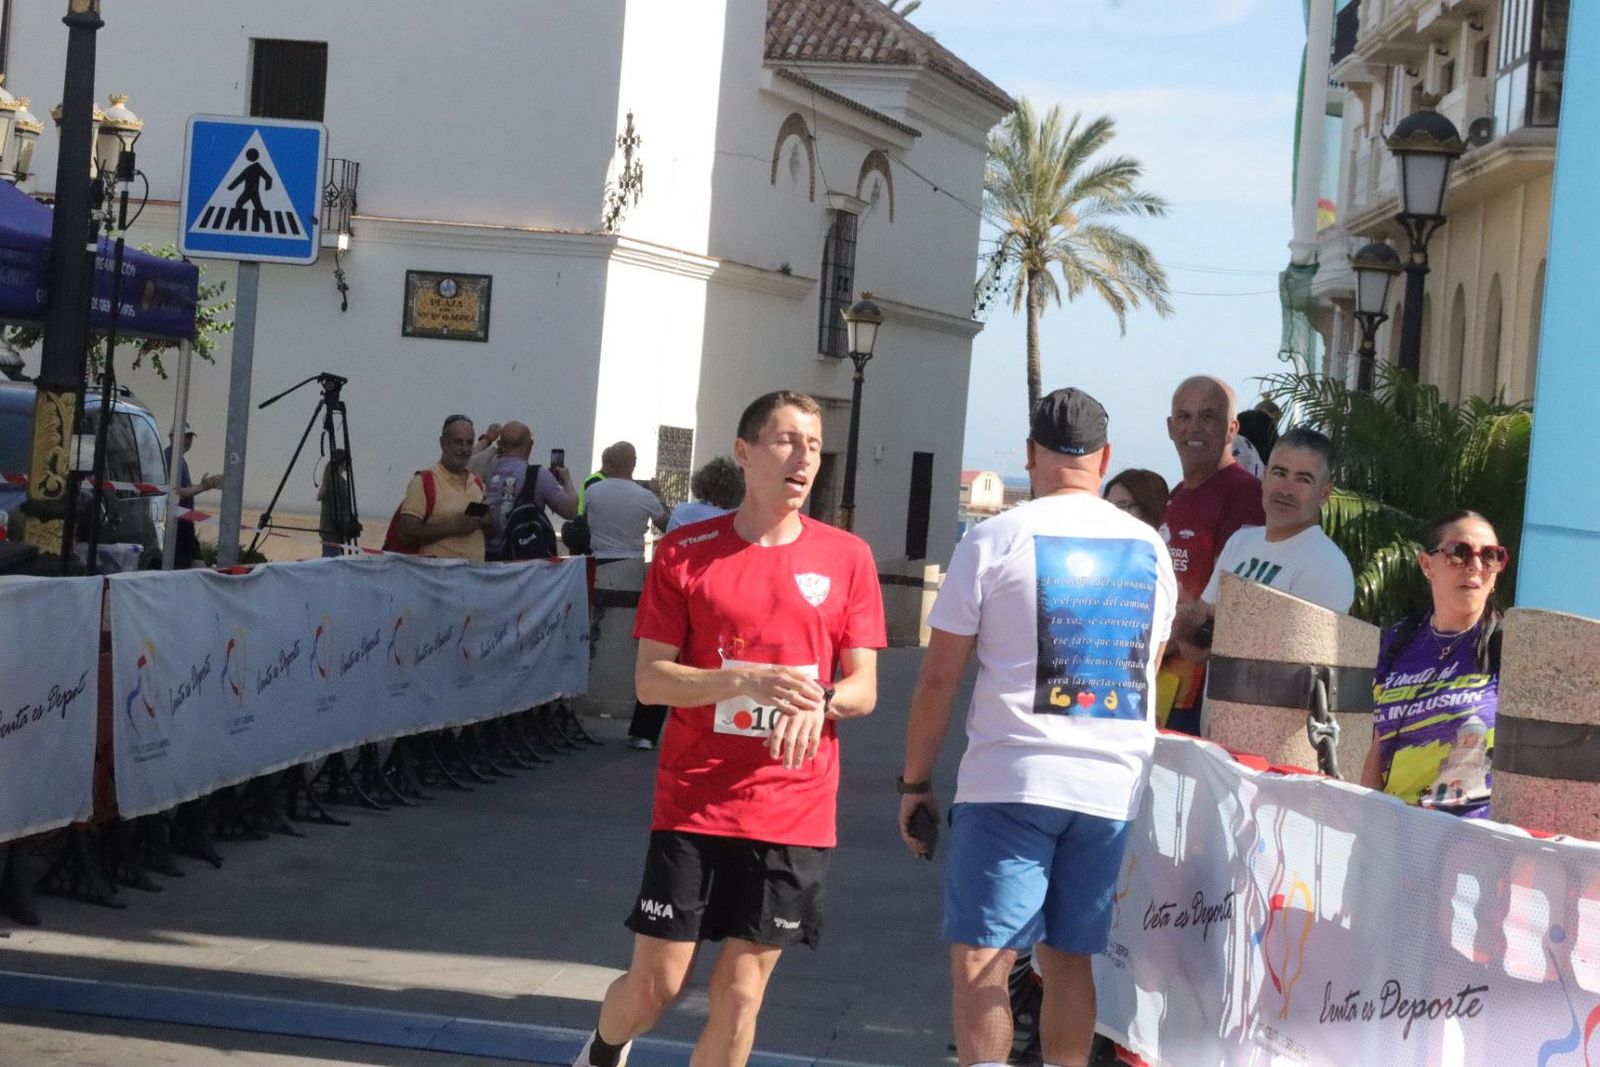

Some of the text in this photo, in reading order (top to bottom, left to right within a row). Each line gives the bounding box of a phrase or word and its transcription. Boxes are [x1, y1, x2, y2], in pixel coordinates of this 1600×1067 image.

[1388, 689, 1485, 721] INCLUSIÓN
[641, 898, 674, 919] VAKA
[1174, 909, 1189, 929] es
[1319, 978, 1490, 1041] Ceuta es Deporte
